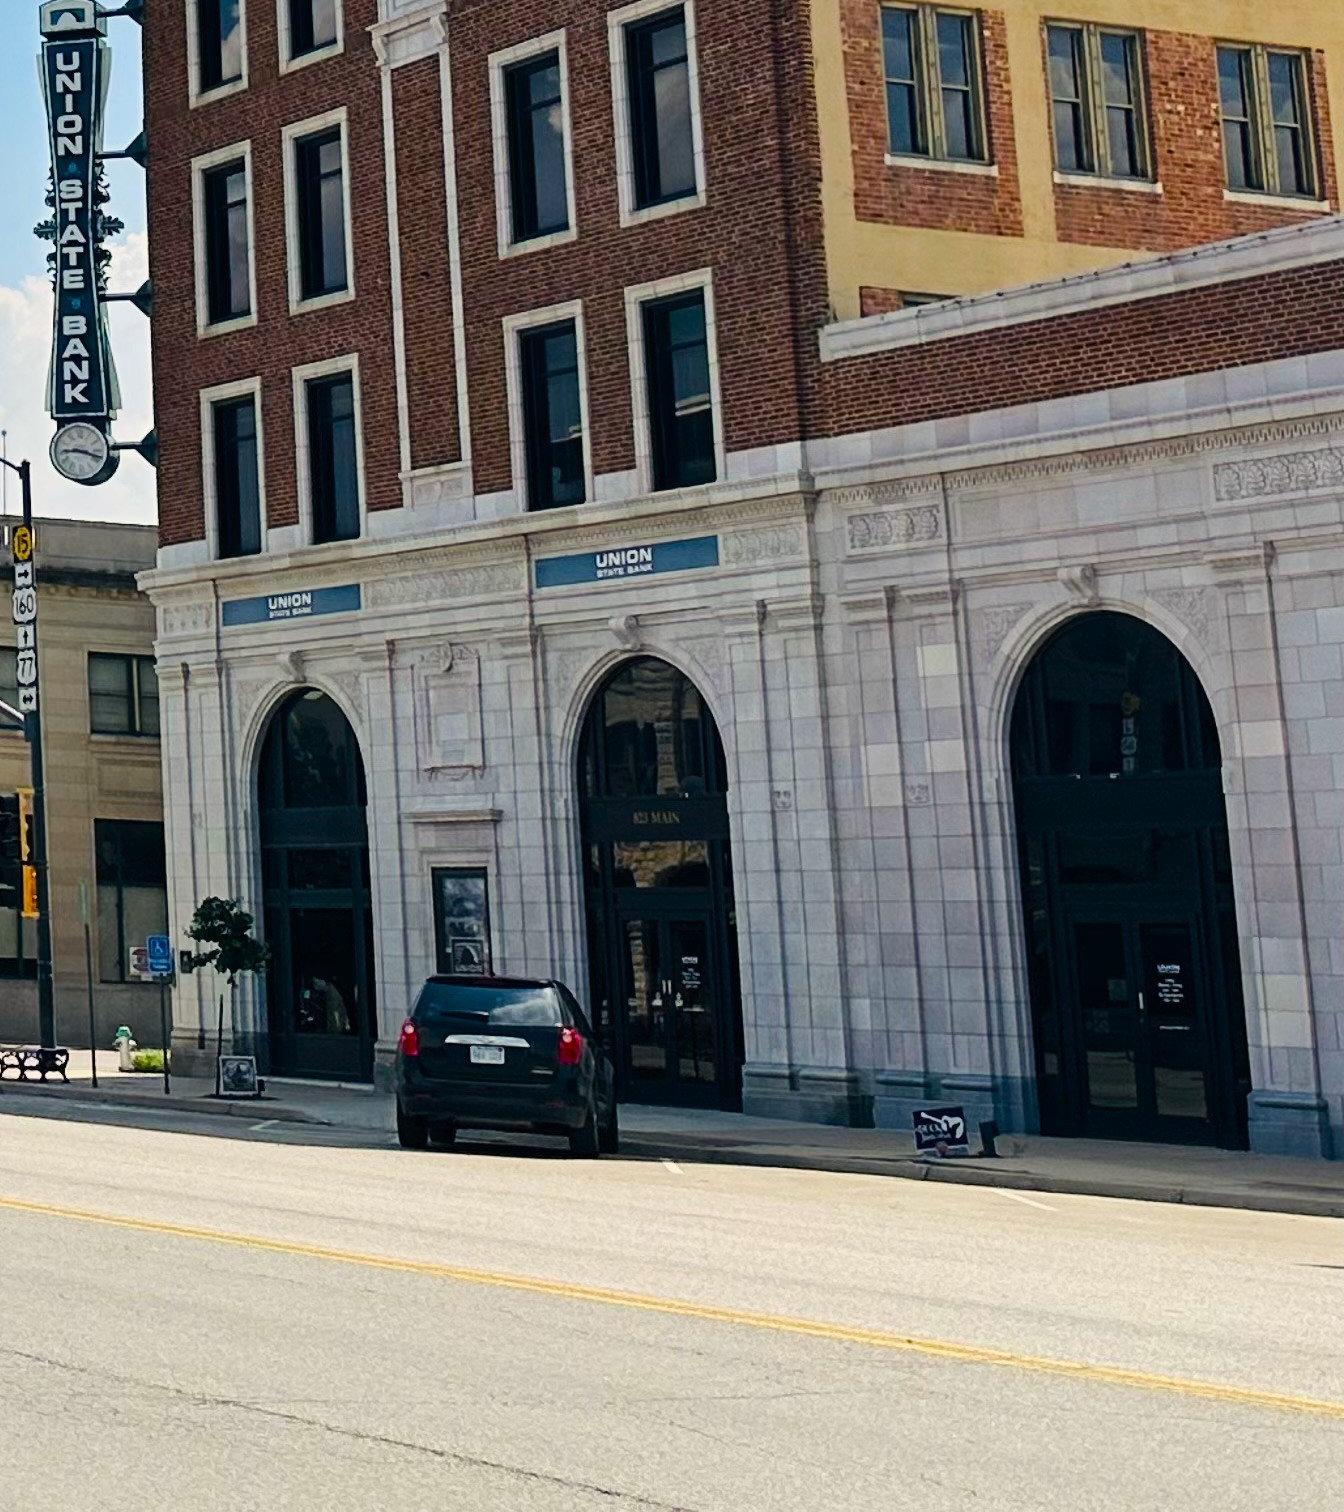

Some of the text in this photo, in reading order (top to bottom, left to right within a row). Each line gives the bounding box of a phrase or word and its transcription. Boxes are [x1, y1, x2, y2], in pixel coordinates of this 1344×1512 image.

[55, 51, 83, 156] UNION
[59, 179, 86, 289] STATE
[62, 315, 89, 403] BANK
[17, 533, 29, 555] 15
[596, 548, 652, 568] UNION
[596, 564, 653, 578] STATE BANK
[15, 594, 34, 615] 160
[268, 592, 311, 609] UNION
[19, 656, 34, 677] 77
[651, 811, 680, 824] MAIN
